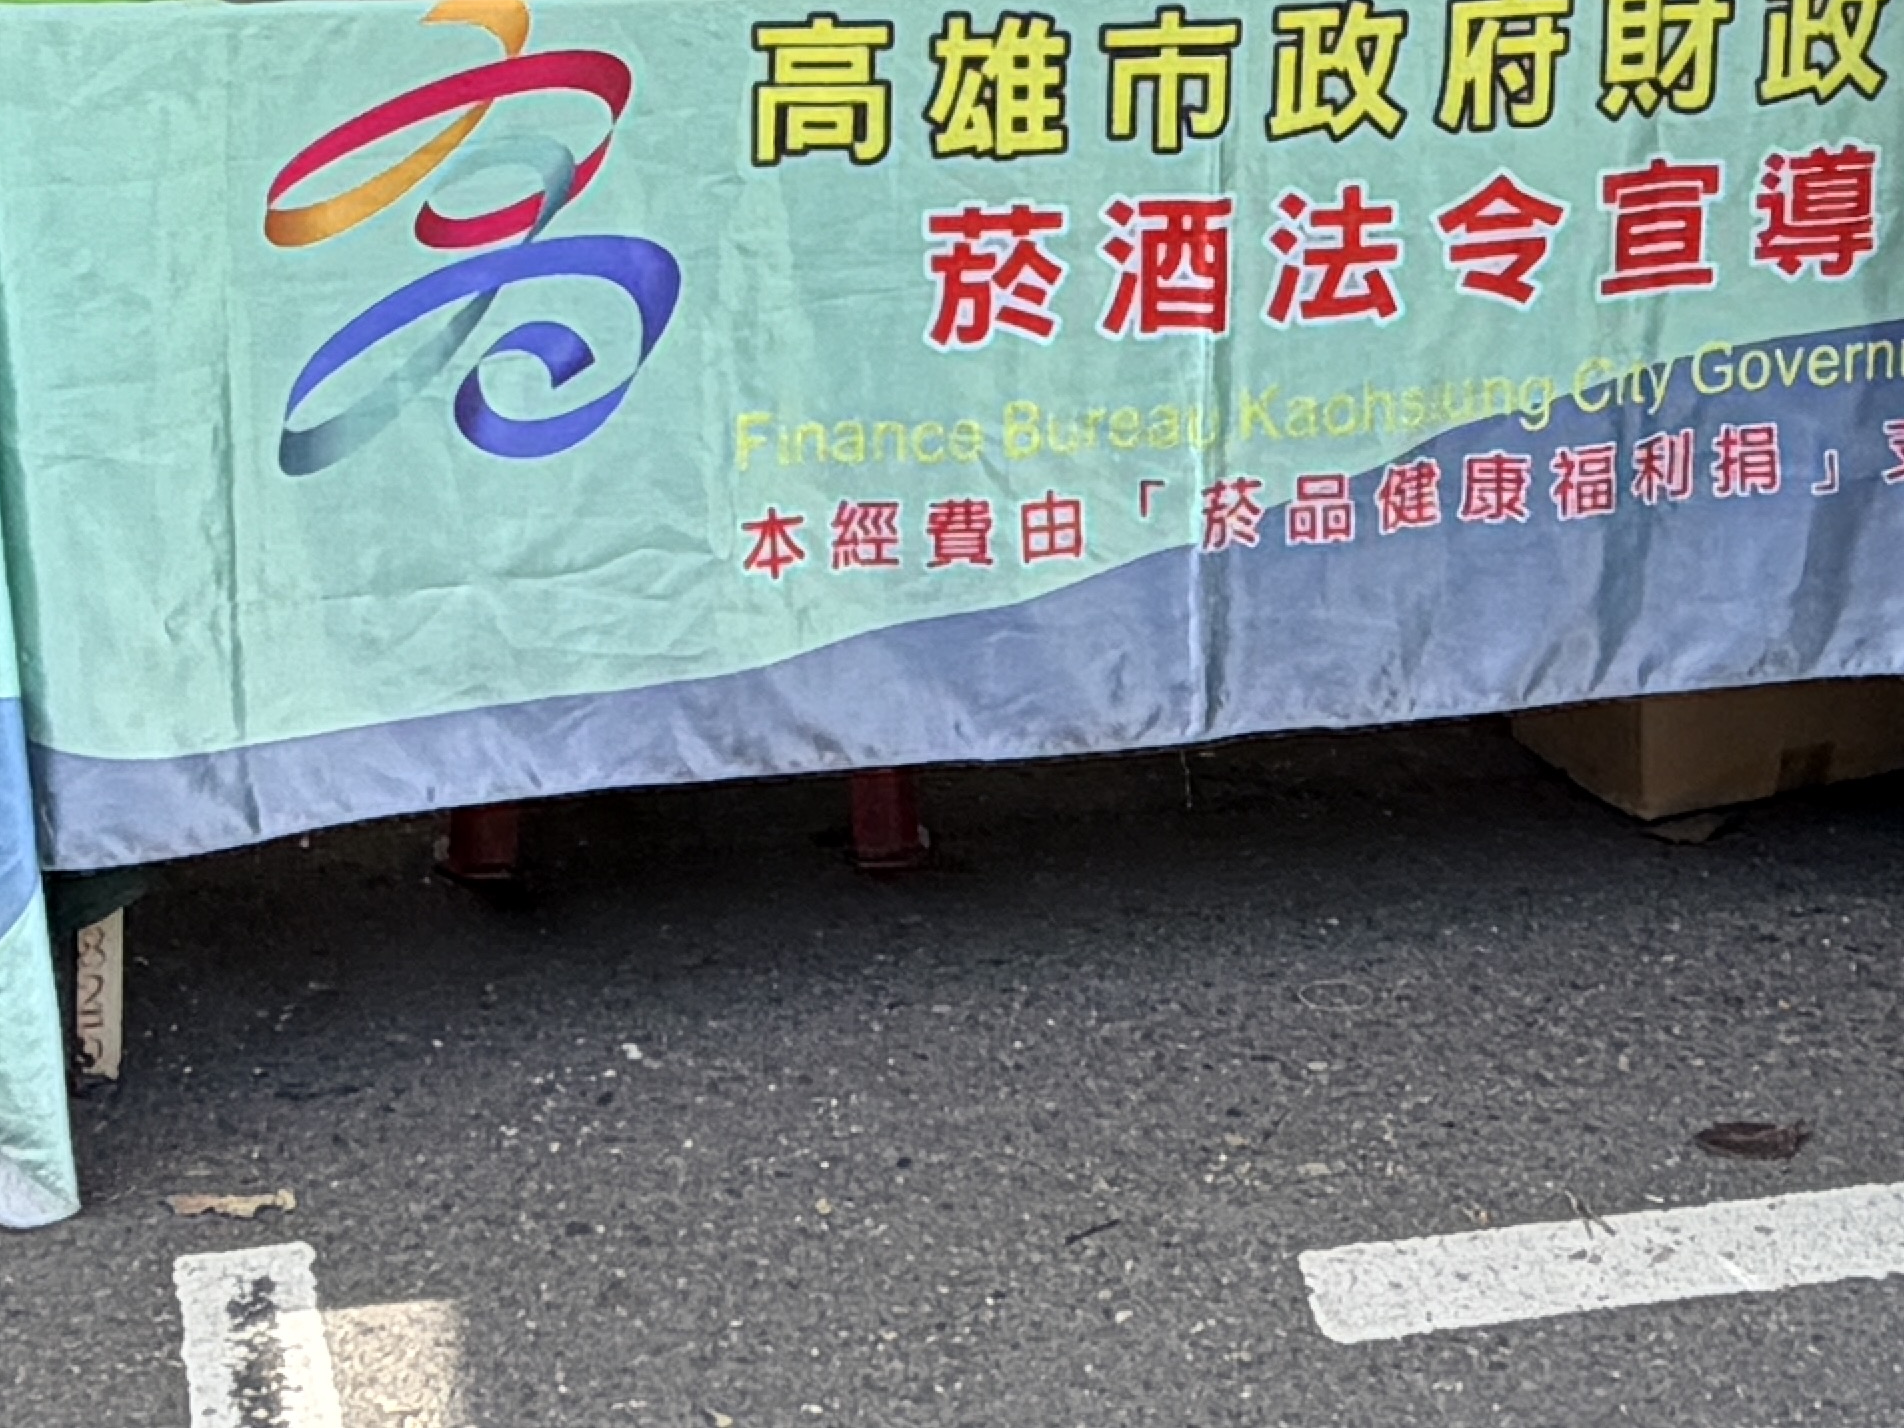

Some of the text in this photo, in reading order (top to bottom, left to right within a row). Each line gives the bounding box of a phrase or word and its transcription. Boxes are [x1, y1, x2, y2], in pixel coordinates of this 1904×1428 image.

[925, 142, 1880, 352] 菸酒法令宣導
[734, 411, 983, 472] Finance
[1002, 400, 1219, 461] Bureau
[1571, 355, 1675, 416] City
